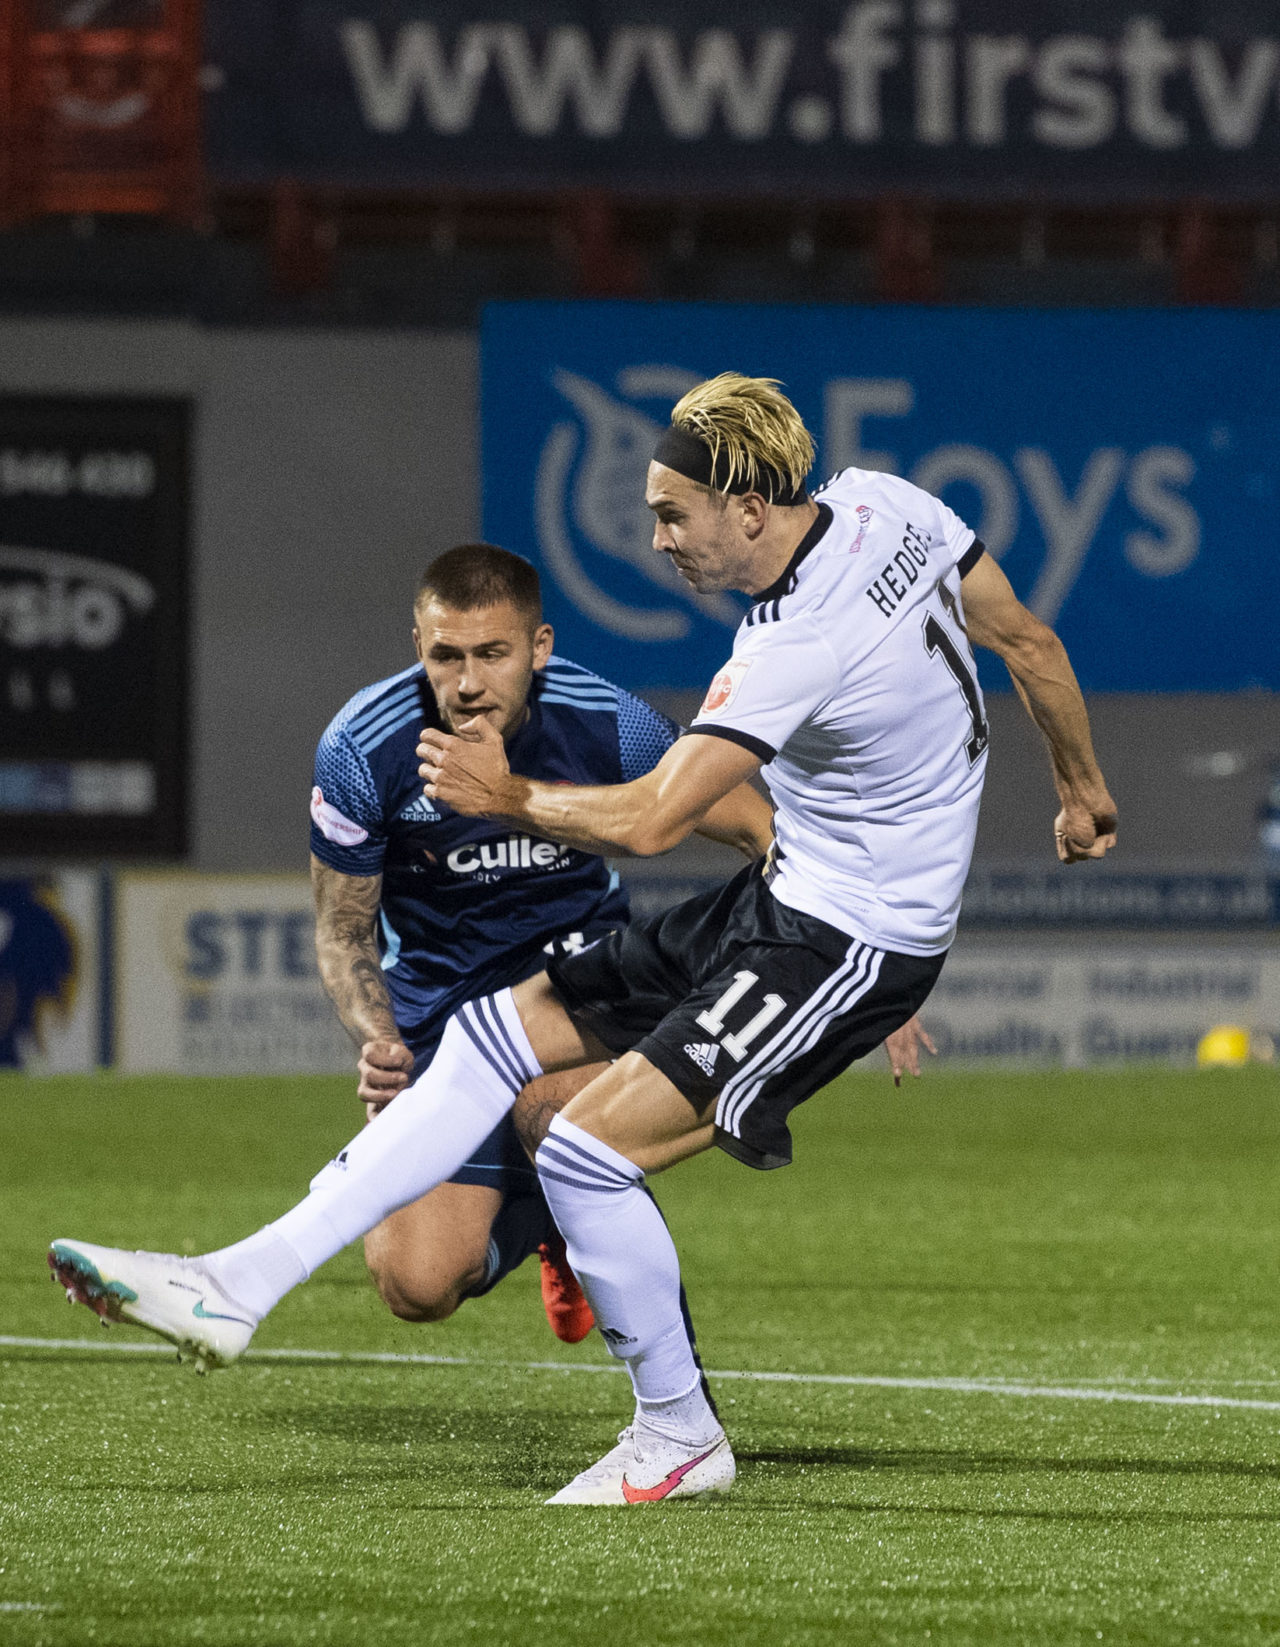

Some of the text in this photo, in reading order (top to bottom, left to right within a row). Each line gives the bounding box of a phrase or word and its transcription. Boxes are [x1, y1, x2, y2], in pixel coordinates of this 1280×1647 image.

[340, 0, 1280, 148] www.firstv
[824, 377, 1202, 628] Foys
[400, 811, 442, 823] adidas
[184, 910, 320, 978] STE
[695, 970, 787, 1062] 11
[683, 1043, 716, 1077] adidas
